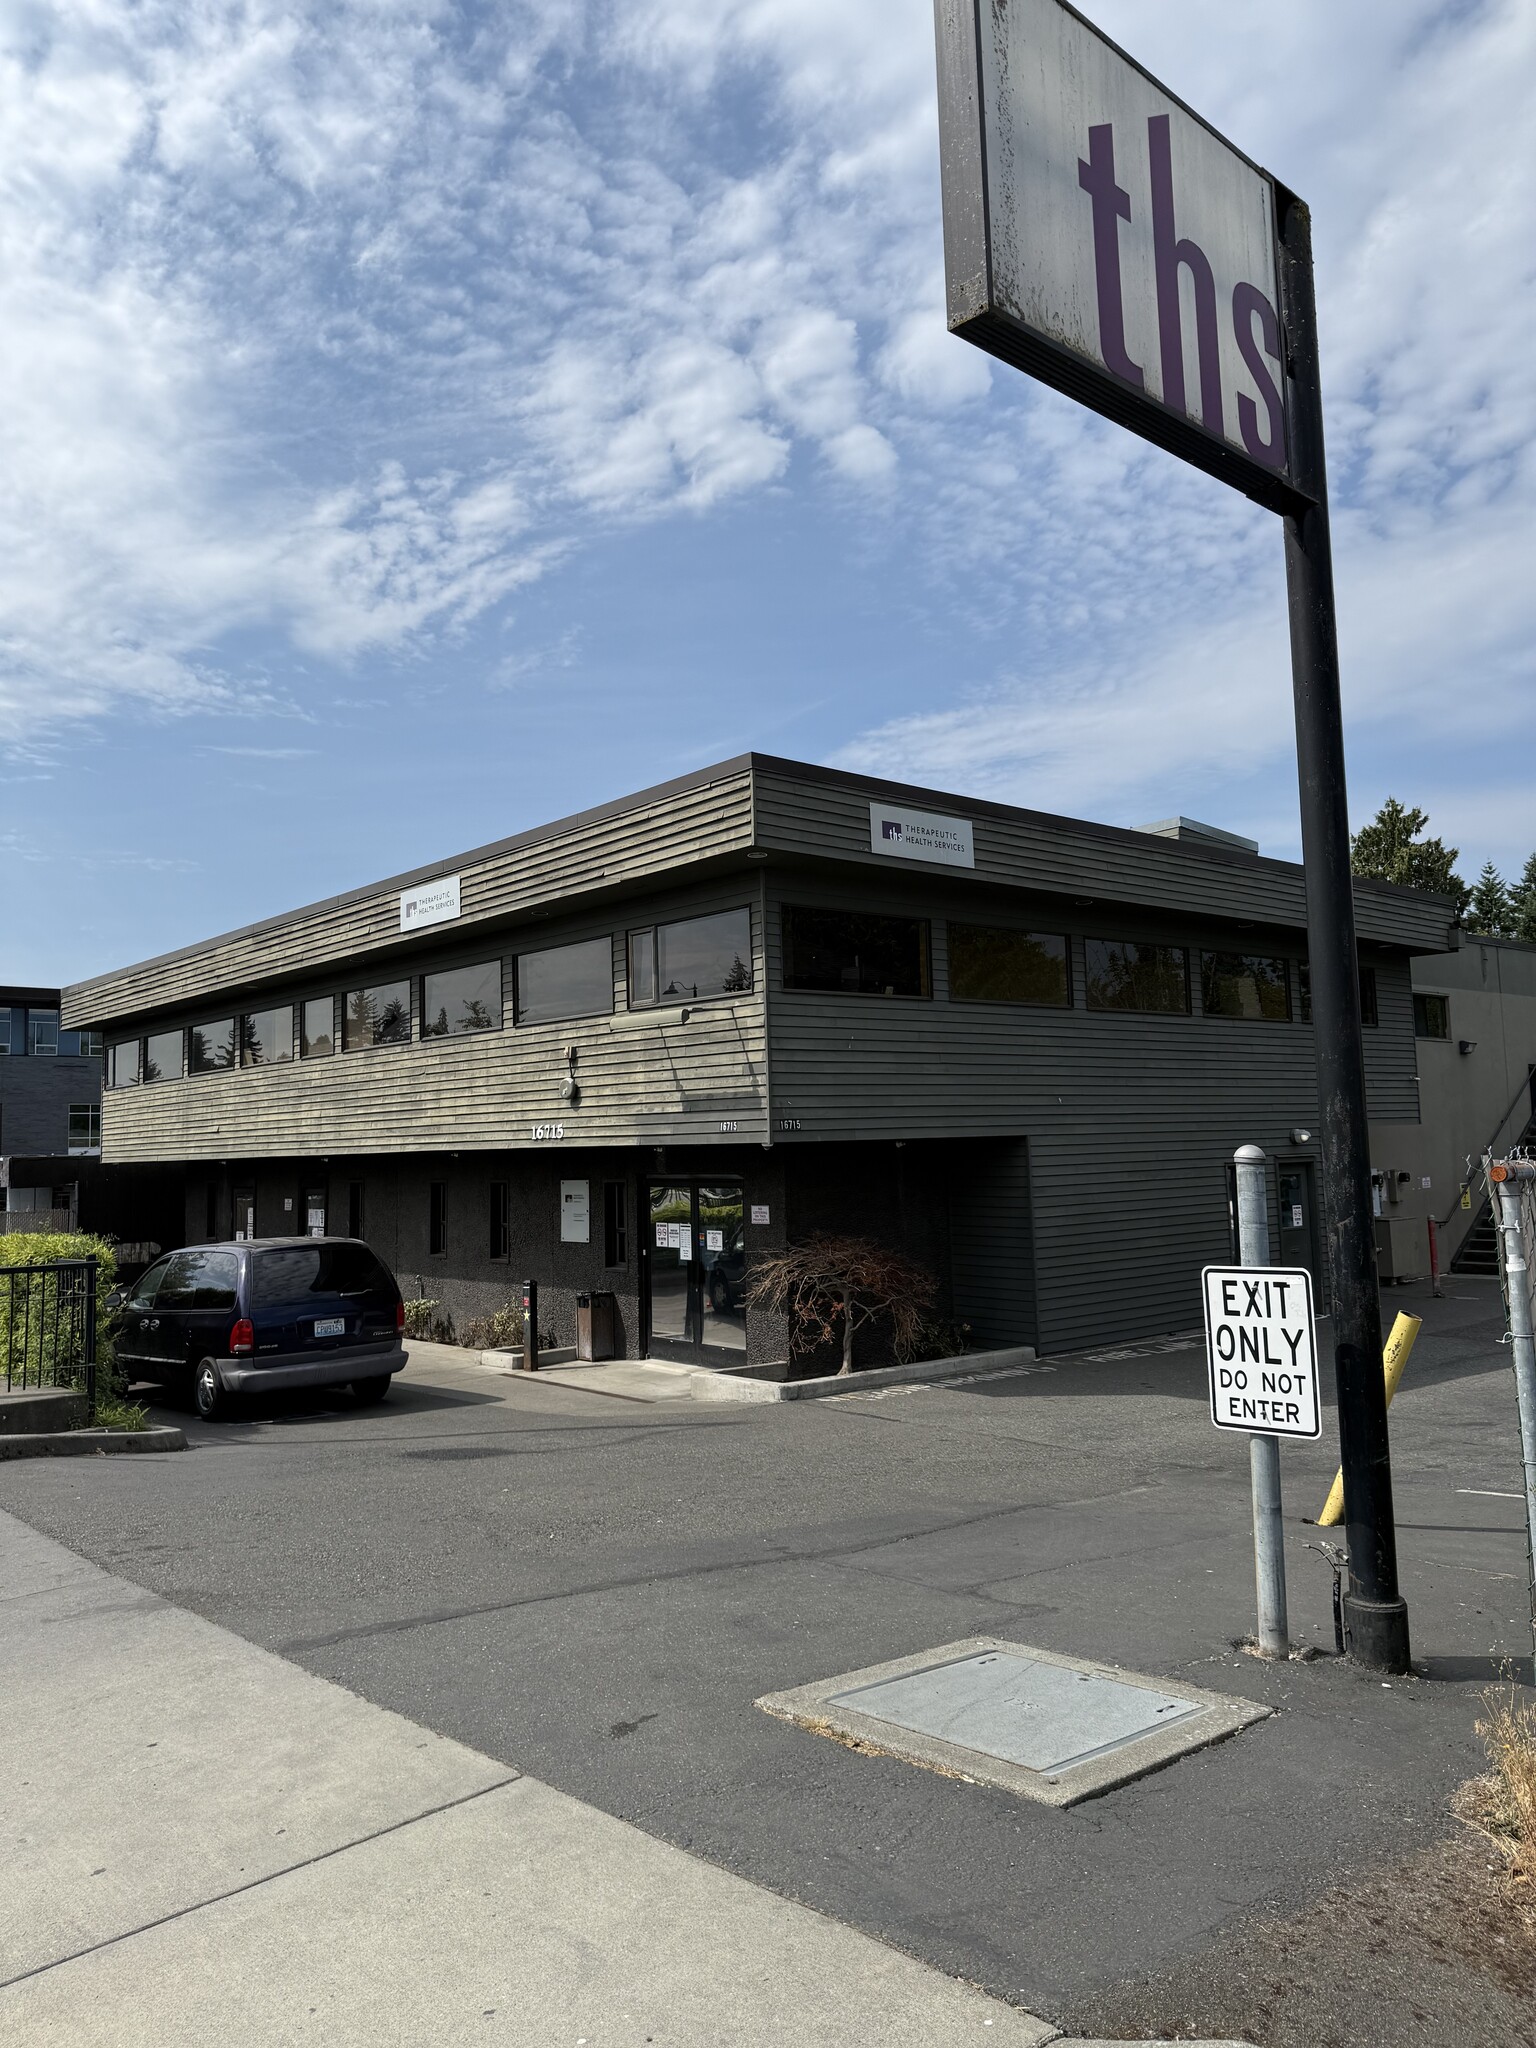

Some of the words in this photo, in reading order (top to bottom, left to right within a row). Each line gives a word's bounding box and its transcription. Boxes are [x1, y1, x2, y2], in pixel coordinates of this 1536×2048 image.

[1077, 113, 1288, 469] ths
[889, 826, 903, 842] ths
[905, 824, 958, 841] THERAPEUTIC
[905, 836, 933, 847] HEALTH
[935, 840, 965, 852] SERVICES
[419, 891, 450, 905] THERAPEUTIC
[419, 905, 434, 914] HEALTH
[436, 899, 455, 910] SERVICES
[531, 1123, 564, 1140] 16715
[720, 1121, 737, 1132] 16715
[780, 1119, 801, 1130] 16715
[1221, 1279, 1291, 1319] EXIT
[1216, 1323, 1304, 1367] ONLY
[1219, 1368, 1248, 1390] DO
[1261, 1372, 1306, 1396] NOT
[1229, 1397, 1300, 1424] ENTER
